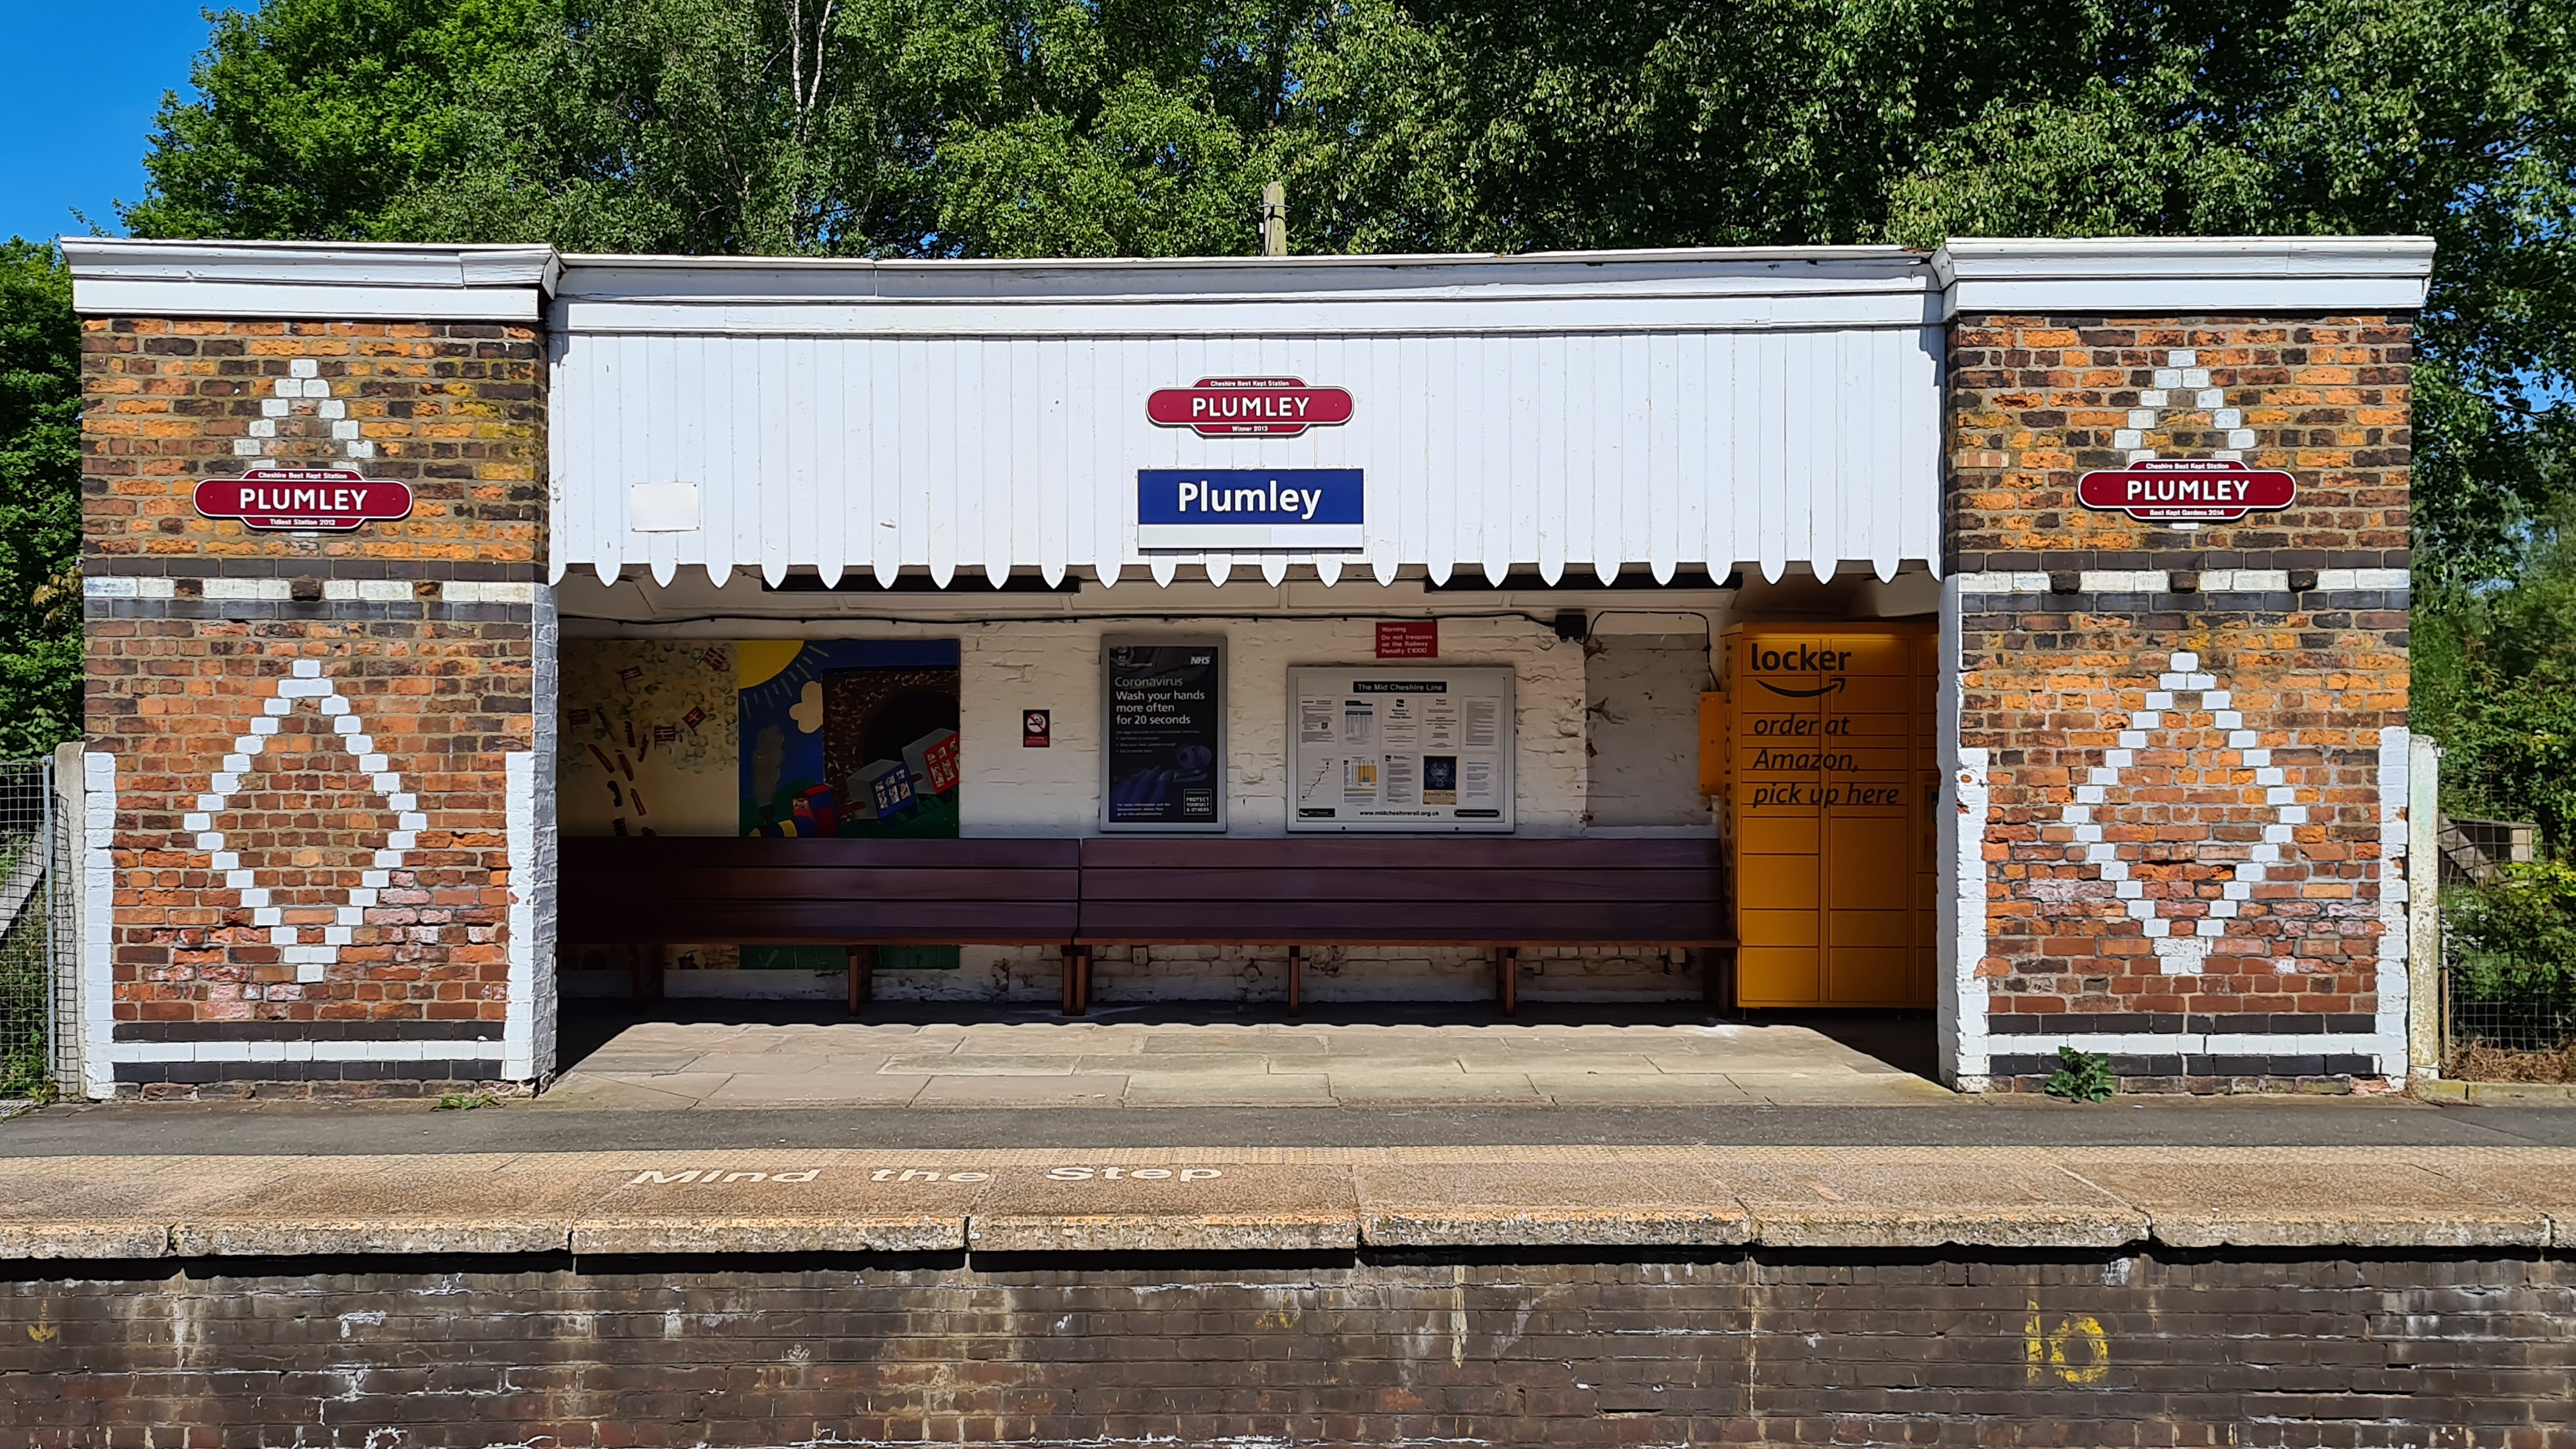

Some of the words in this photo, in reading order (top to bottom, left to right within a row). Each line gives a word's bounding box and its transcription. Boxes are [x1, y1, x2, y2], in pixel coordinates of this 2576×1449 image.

[1192, 397, 1310, 417] PLUMLEY
[240, 488, 368, 510] PLUMLEY
[1178, 480, 1322, 520] Plumley
[2127, 480, 2250, 501] PLUMLEY
[1190, 656, 1210, 664] NHS
[1751, 643, 1851, 671] locker
[1114, 676, 1183, 687] Coronavirus
[1116, 691, 1145, 700] Wash
[1147, 693, 1172, 702] your
[1174, 690, 1205, 700] hands
[1146, 702, 1175, 712] often
[1116, 714, 1132, 724] for
[1134, 715, 1147, 724] 20
[1149, 714, 1191, 724] seconds
[1754, 714, 1820, 735] order
[1825, 716, 1851, 735] at
[1752, 749, 1859, 772] Amazon,
[1752, 783, 1803, 808] pick
[1809, 788, 1839, 808] up
[1846, 783, 1899, 804] here
[631, 1169, 821, 1184] Mind
[871, 1169, 990, 1182] the
[1045, 1167, 1222, 1183] Step
